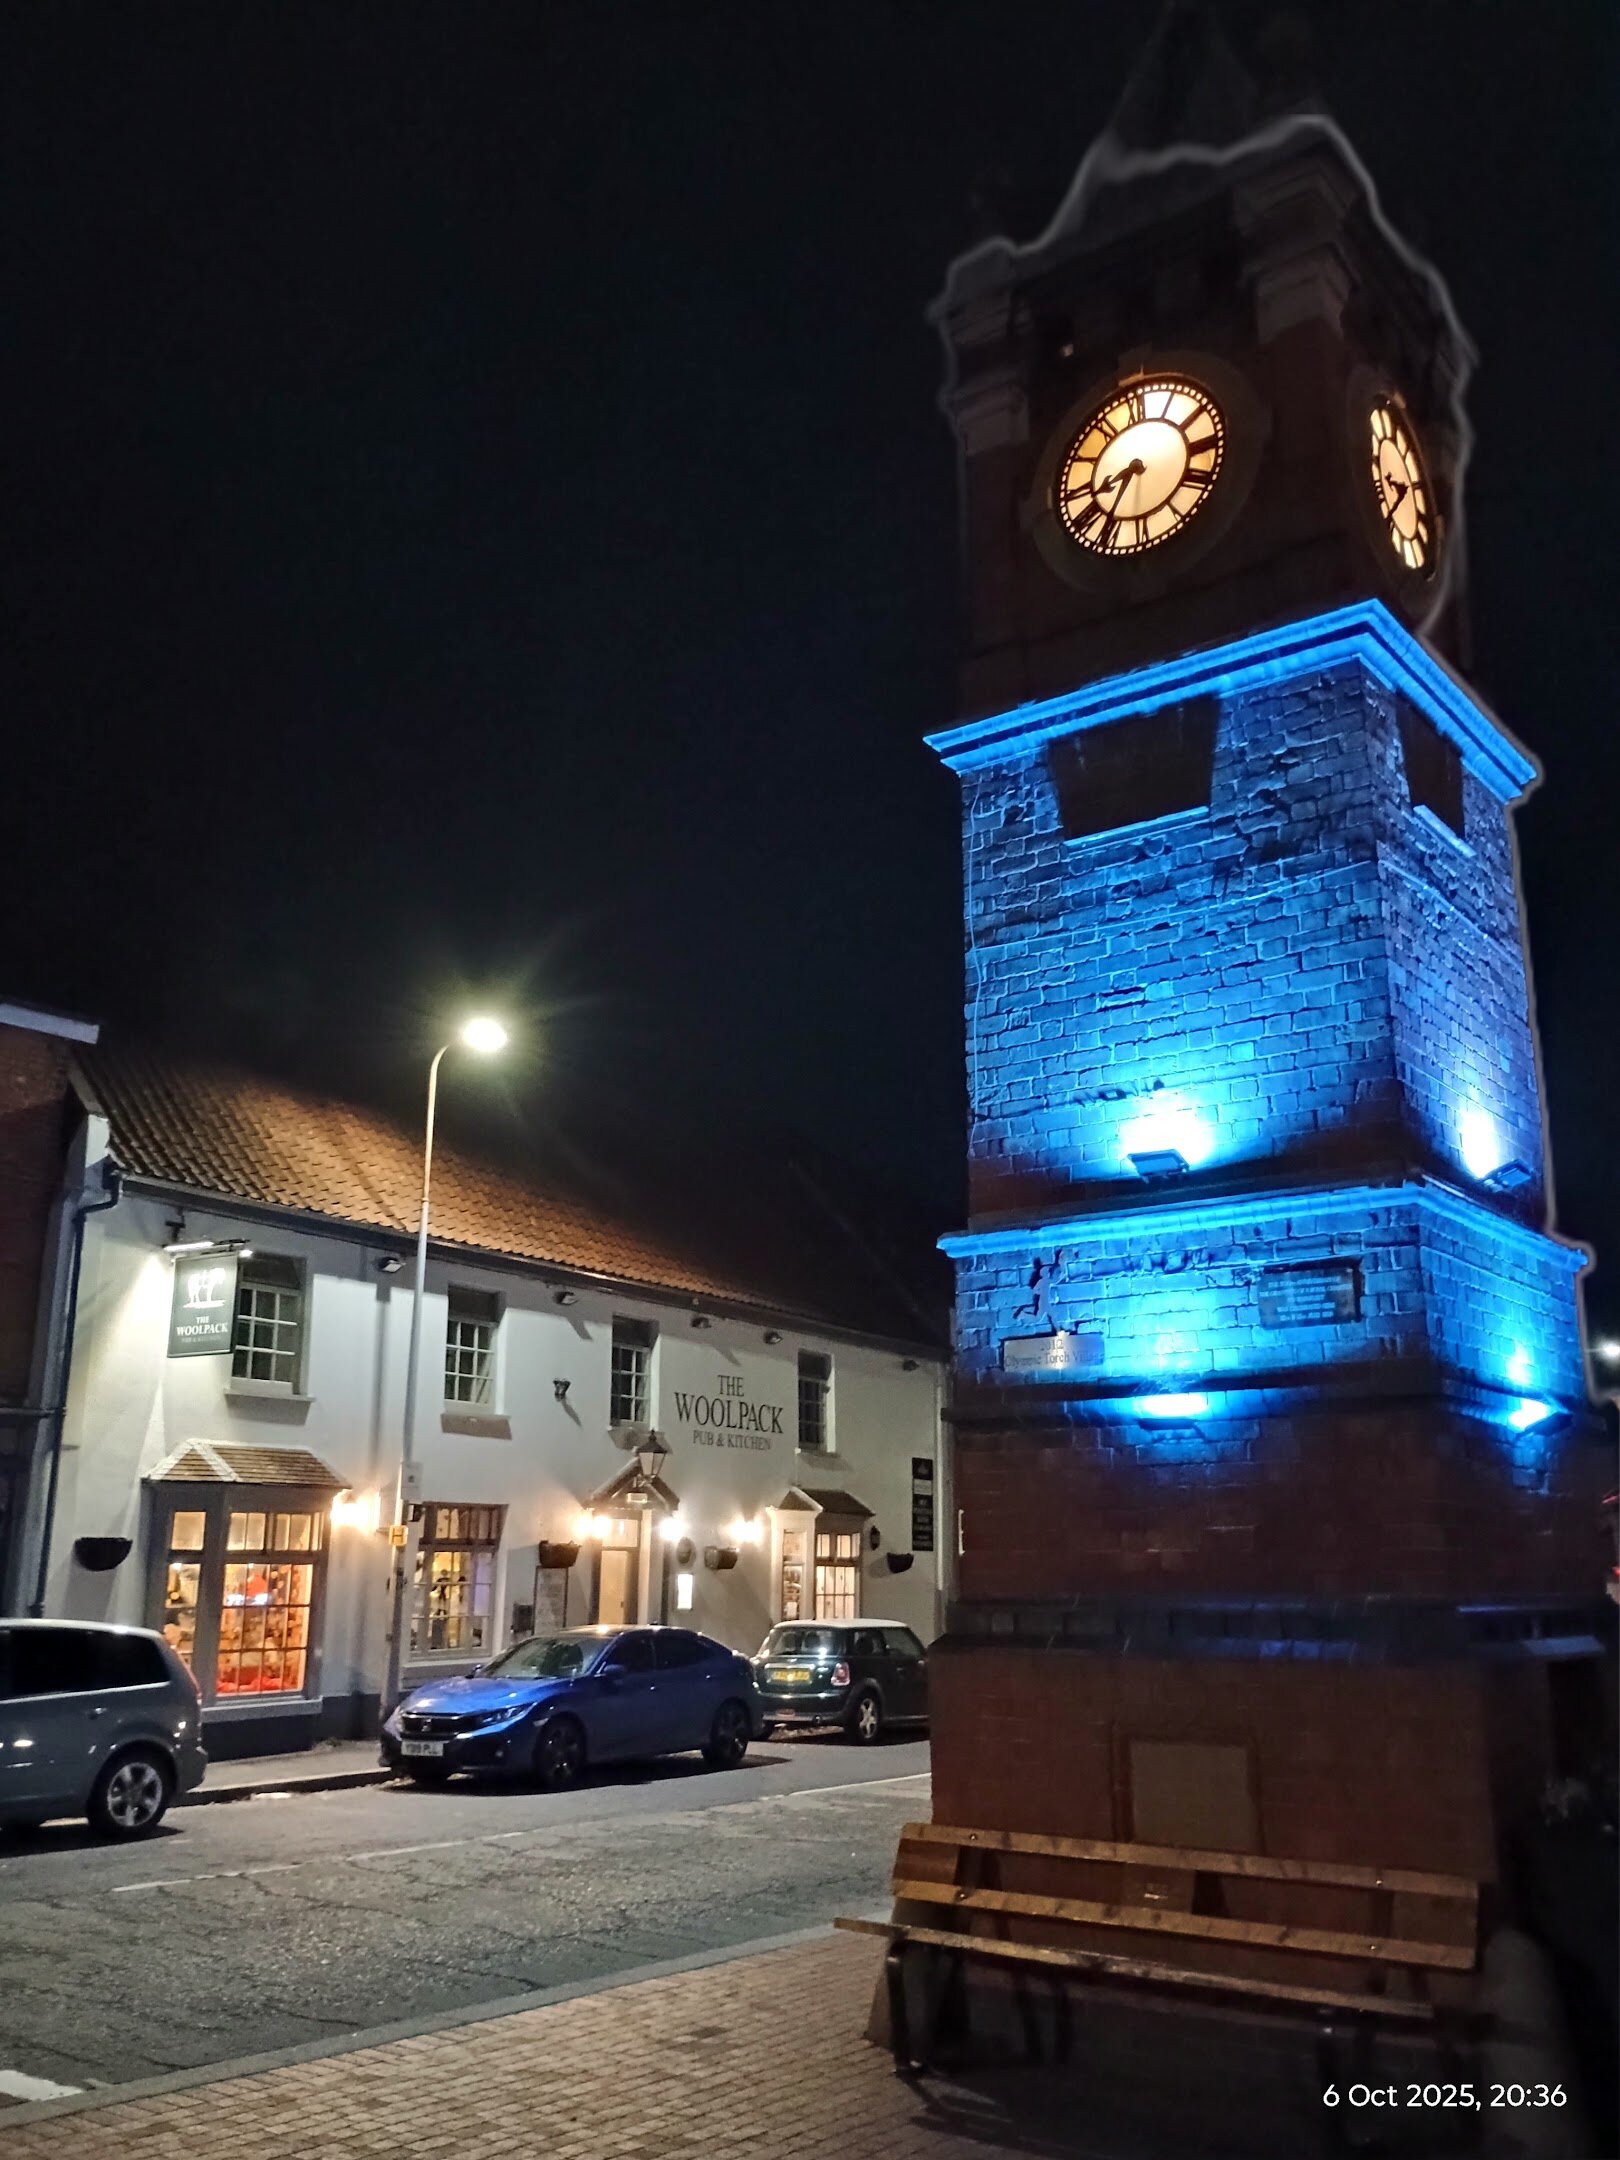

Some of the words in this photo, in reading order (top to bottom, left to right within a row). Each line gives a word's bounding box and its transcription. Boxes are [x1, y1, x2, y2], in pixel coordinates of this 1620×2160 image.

[196, 1316, 210, 1324] THE
[176, 1322, 228, 1336] WOOLPACK
[1044, 1352, 1070, 1365] Torch
[717, 1374, 745, 1397] THE
[674, 1392, 783, 1434] WOOLPACK
[693, 1430, 714, 1446] PUB
[716, 1433, 724, 1447] &
[727, 1433, 772, 1451] KITCHEN
